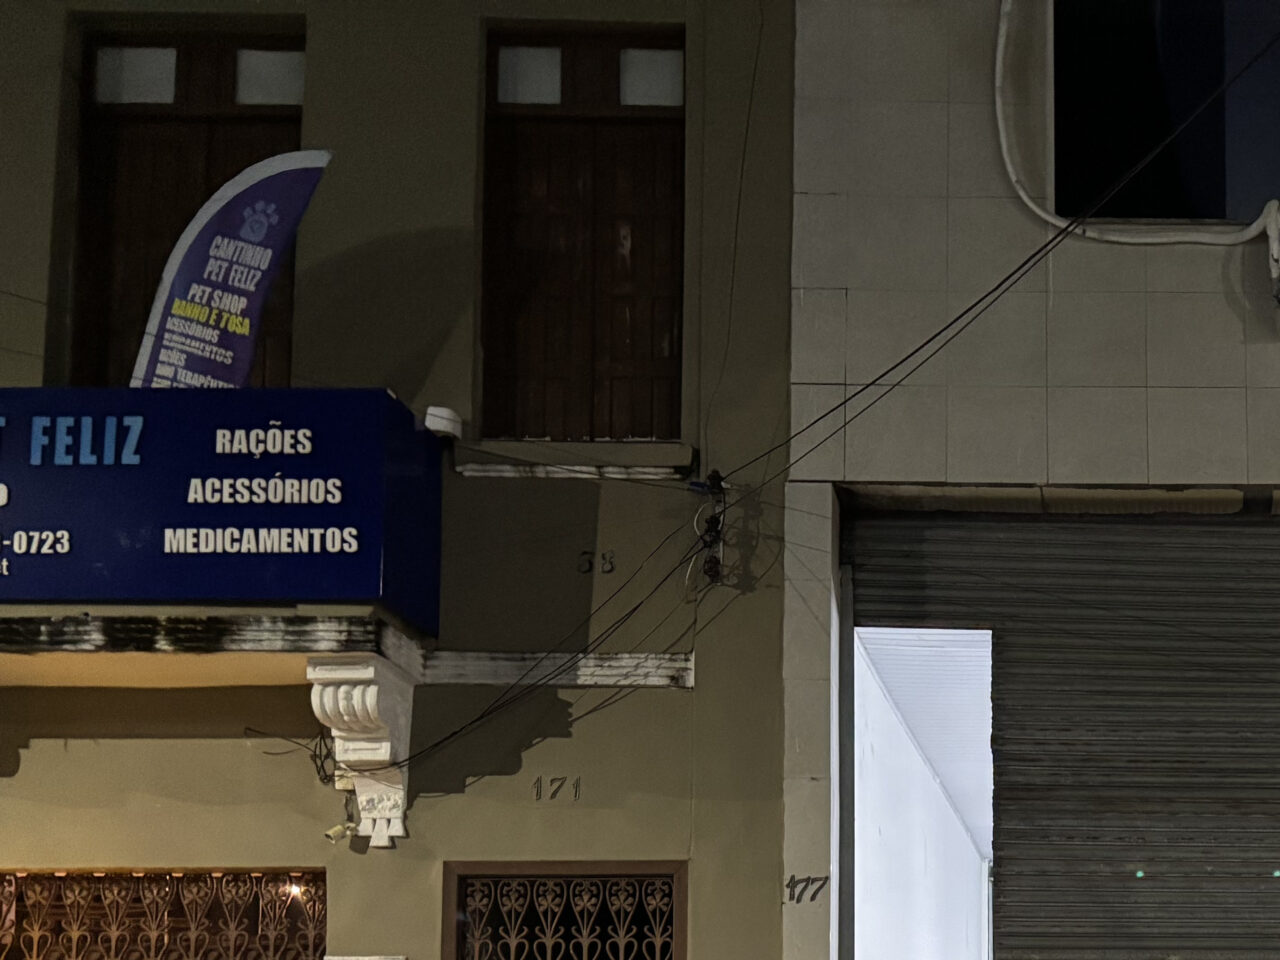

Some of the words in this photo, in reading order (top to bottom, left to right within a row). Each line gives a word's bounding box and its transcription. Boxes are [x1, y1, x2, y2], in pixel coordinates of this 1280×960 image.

[209, 235, 273, 271] CANTINHO
[203, 258, 229, 284] PET
[228, 264, 262, 292] FELIZ
[187, 283, 212, 304] PET
[211, 290, 248, 315] SHOP
[209, 309, 220, 326] E
[220, 312, 250, 336] TOSA
[29, 415, 144, 466] FELIZ
[215, 419, 313, 459] RAÇÕES
[187, 472, 342, 504] ACESSÓRIOS
[164, 527, 359, 554] MEDICAMENTOS
[531, 775, 581, 801] 171
